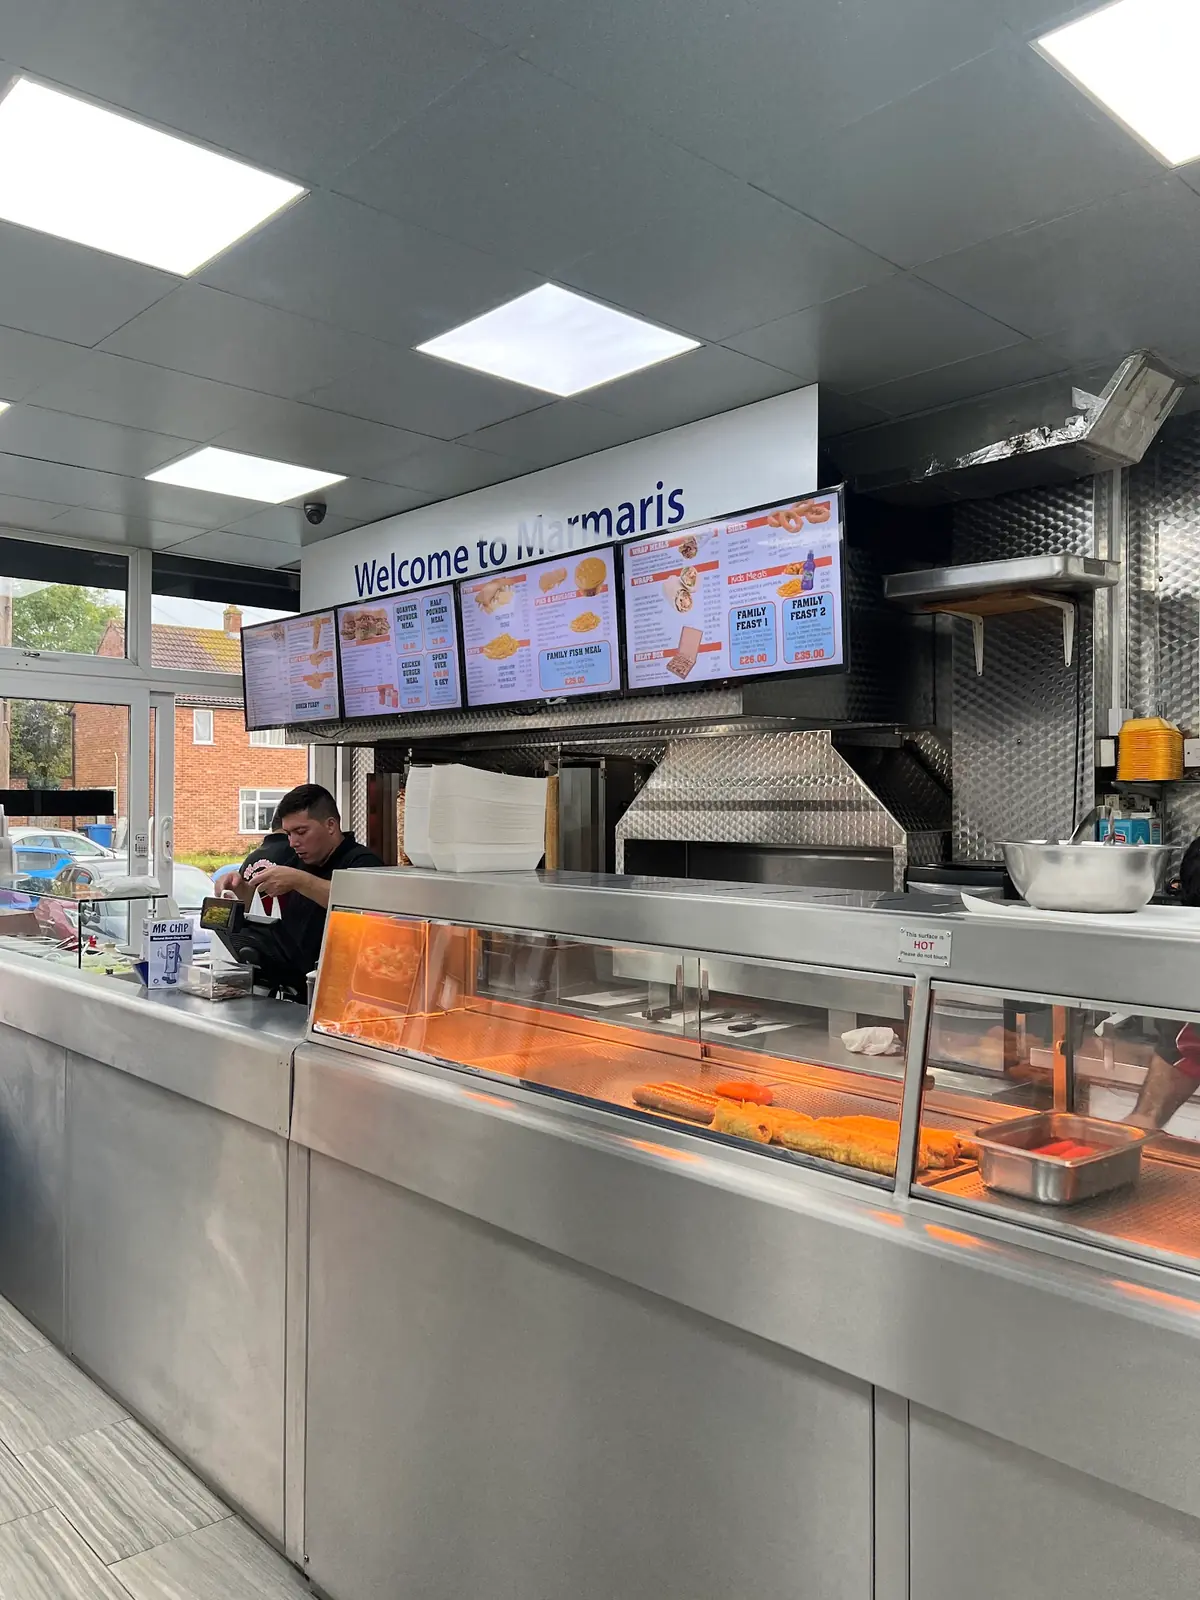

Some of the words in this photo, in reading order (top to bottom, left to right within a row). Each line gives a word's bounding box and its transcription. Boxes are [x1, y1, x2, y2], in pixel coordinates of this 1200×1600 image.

[354, 545, 469, 597] Welcome
[476, 536, 507, 568] to
[516, 480, 685, 558] Marmaris
[631, 546, 649, 555] WRAP
[633, 576, 654, 585] WRAPS
[731, 574, 745, 584] Kids
[746, 570, 768, 581] Meals
[430, 598, 442, 607] HALF
[792, 595, 824, 609] FAMILY
[396, 604, 417, 614] QUARTER
[425, 606, 448, 616] POUNDER
[737, 606, 767, 619] FAMILY
[790, 608, 818, 621] FEAST
[820, 606, 827, 617] 2
[397, 612, 418, 622] POUNDER
[430, 615, 444, 624] MEAL
[401, 621, 414, 629] MEAL
[736, 618, 763, 631] FEAST
[432, 653, 448, 661] SPEND
[546, 650, 568, 661] FAMILY
[569, 648, 583, 657] FISH
[584, 645, 602, 655] MEAL
[739, 653, 767, 665] £26.00
[401, 660, 421, 669] CHICKEN
[434, 661, 447, 669] OVER
[403, 668, 421, 676] BURGER
[406, 677, 419, 685] MEAL
[152, 923, 167, 933] MR
[169, 923, 189, 933] CHIP
[913, 940, 935, 950] HOT
